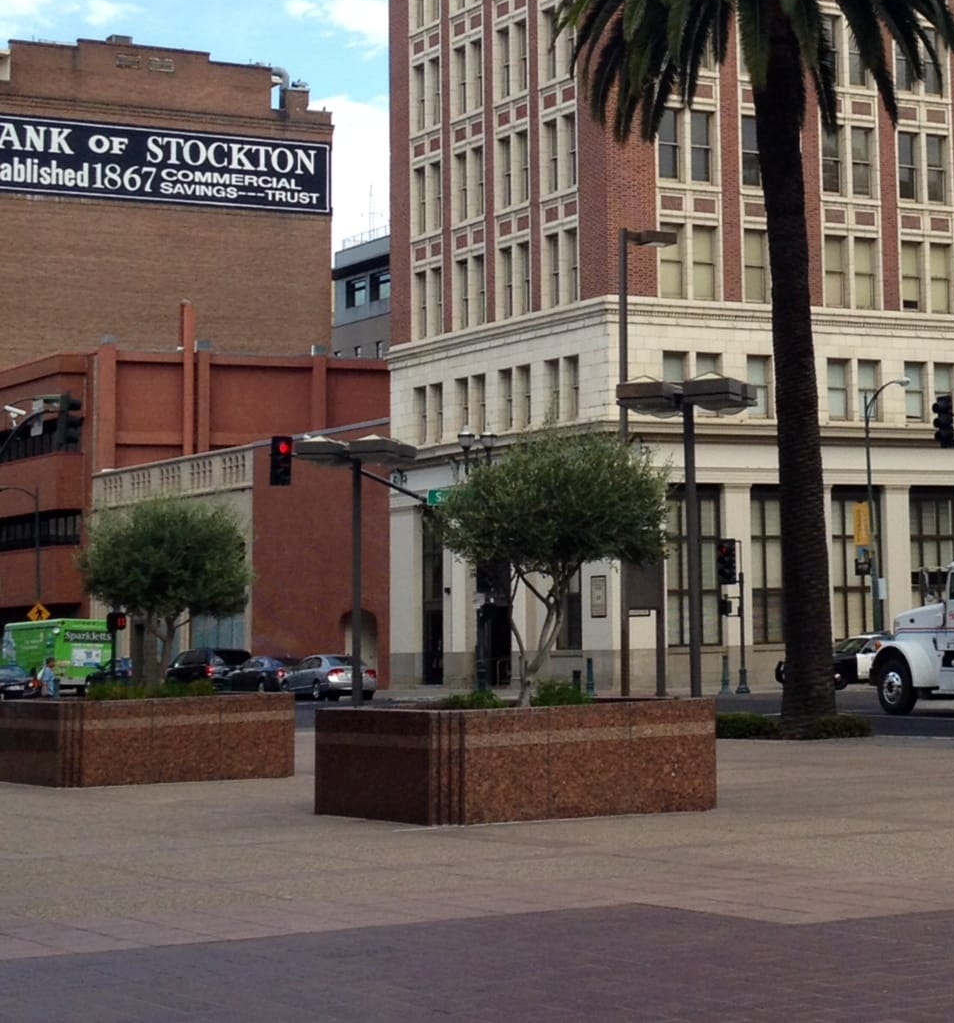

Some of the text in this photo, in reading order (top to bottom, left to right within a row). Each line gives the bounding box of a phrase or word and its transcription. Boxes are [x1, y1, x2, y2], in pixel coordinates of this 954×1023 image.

[88, 134, 128, 155] OF
[146, 135, 317, 176] STOCKTON
[0, 157, 157, 192] ablished 1867
[161, 168, 302, 190] COMMERCIAL
[65, 631, 112, 641] Sparkletts
